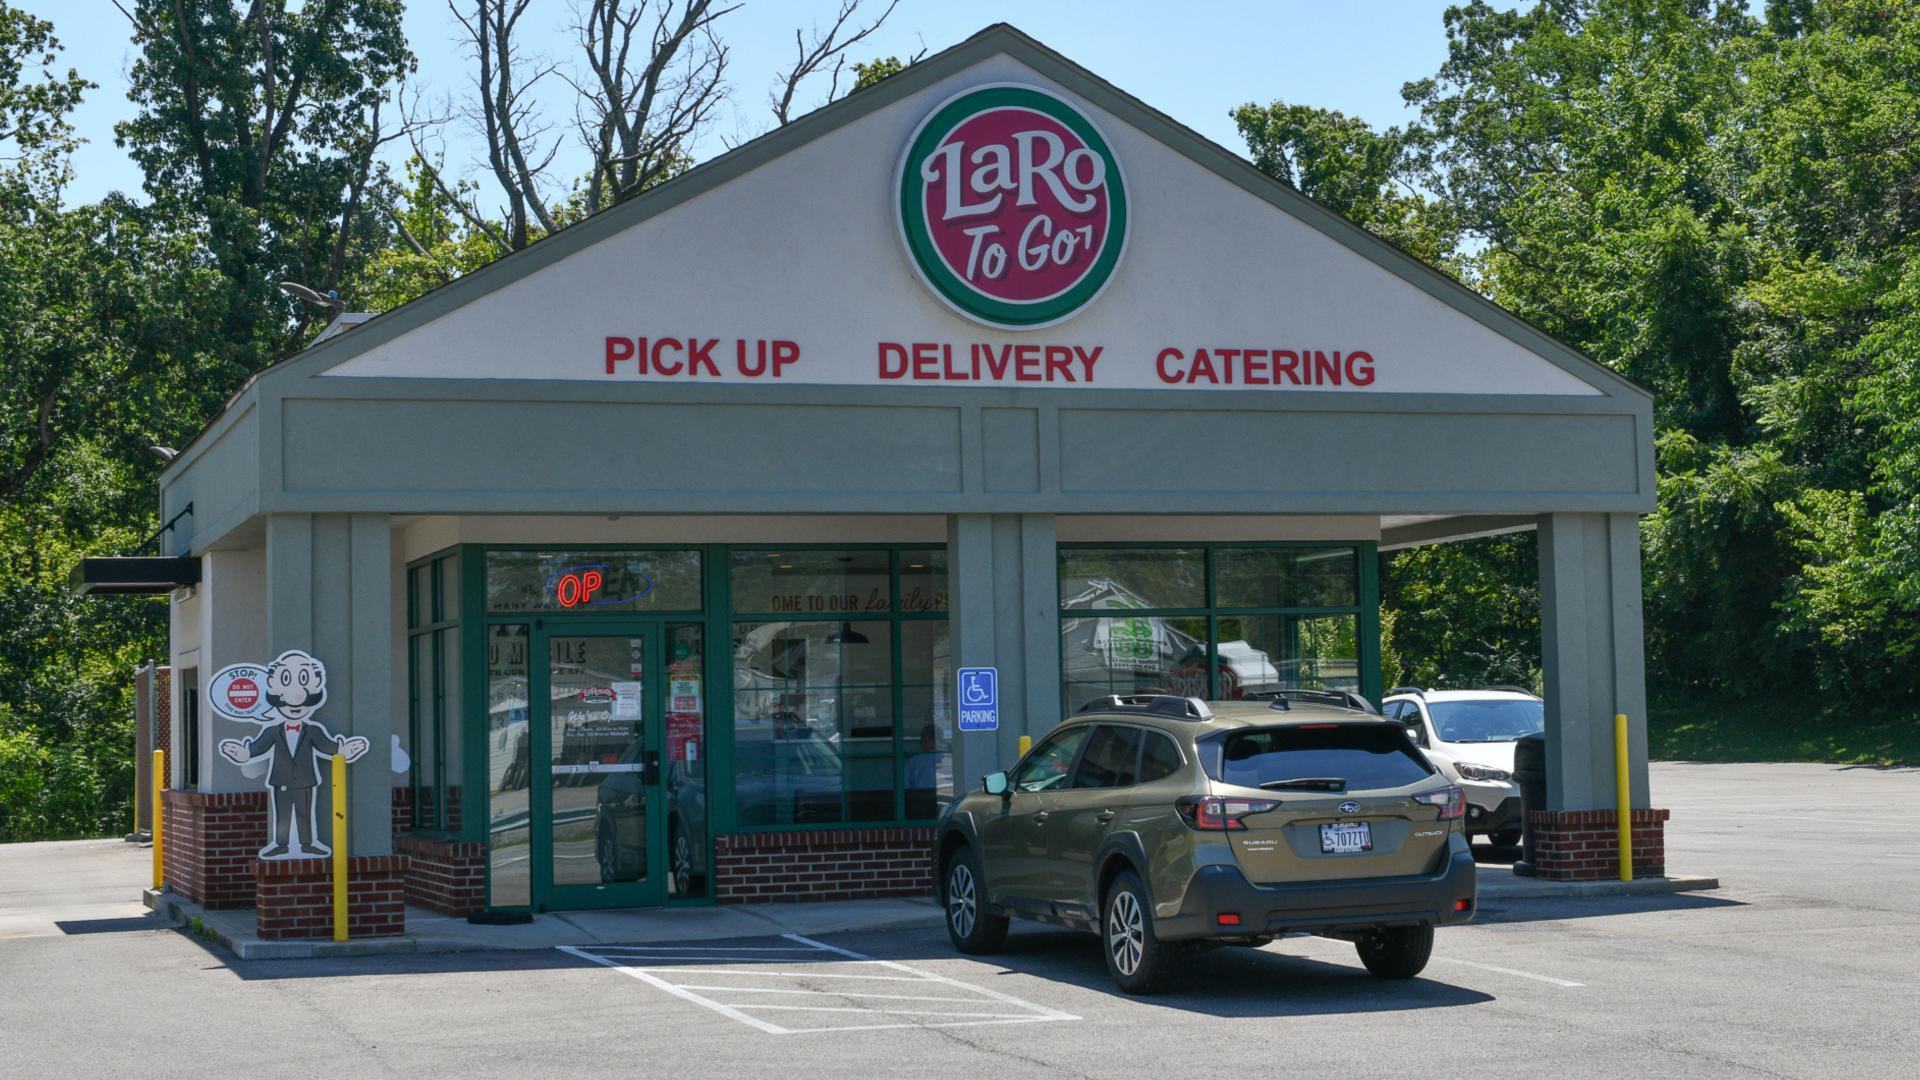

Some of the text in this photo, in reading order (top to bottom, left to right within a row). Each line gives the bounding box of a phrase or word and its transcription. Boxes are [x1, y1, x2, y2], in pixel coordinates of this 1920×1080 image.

[921, 130, 1106, 221] LaRo
[963, 225, 1007, 280] To
[606, 337, 800, 377] PICK UP
[878, 342, 1104, 382] DELIVERY
[1156, 347, 1375, 386] CATERING
[772, 595, 801, 612] OME
[807, 595, 823, 612] TO
[830, 595, 858, 611] OUR
[864, 587, 934, 612] faily
[229, 669, 258, 680] STOP!
[961, 710, 995, 723] PARKING
[1414, 830, 1444, 838] OUTBACK
